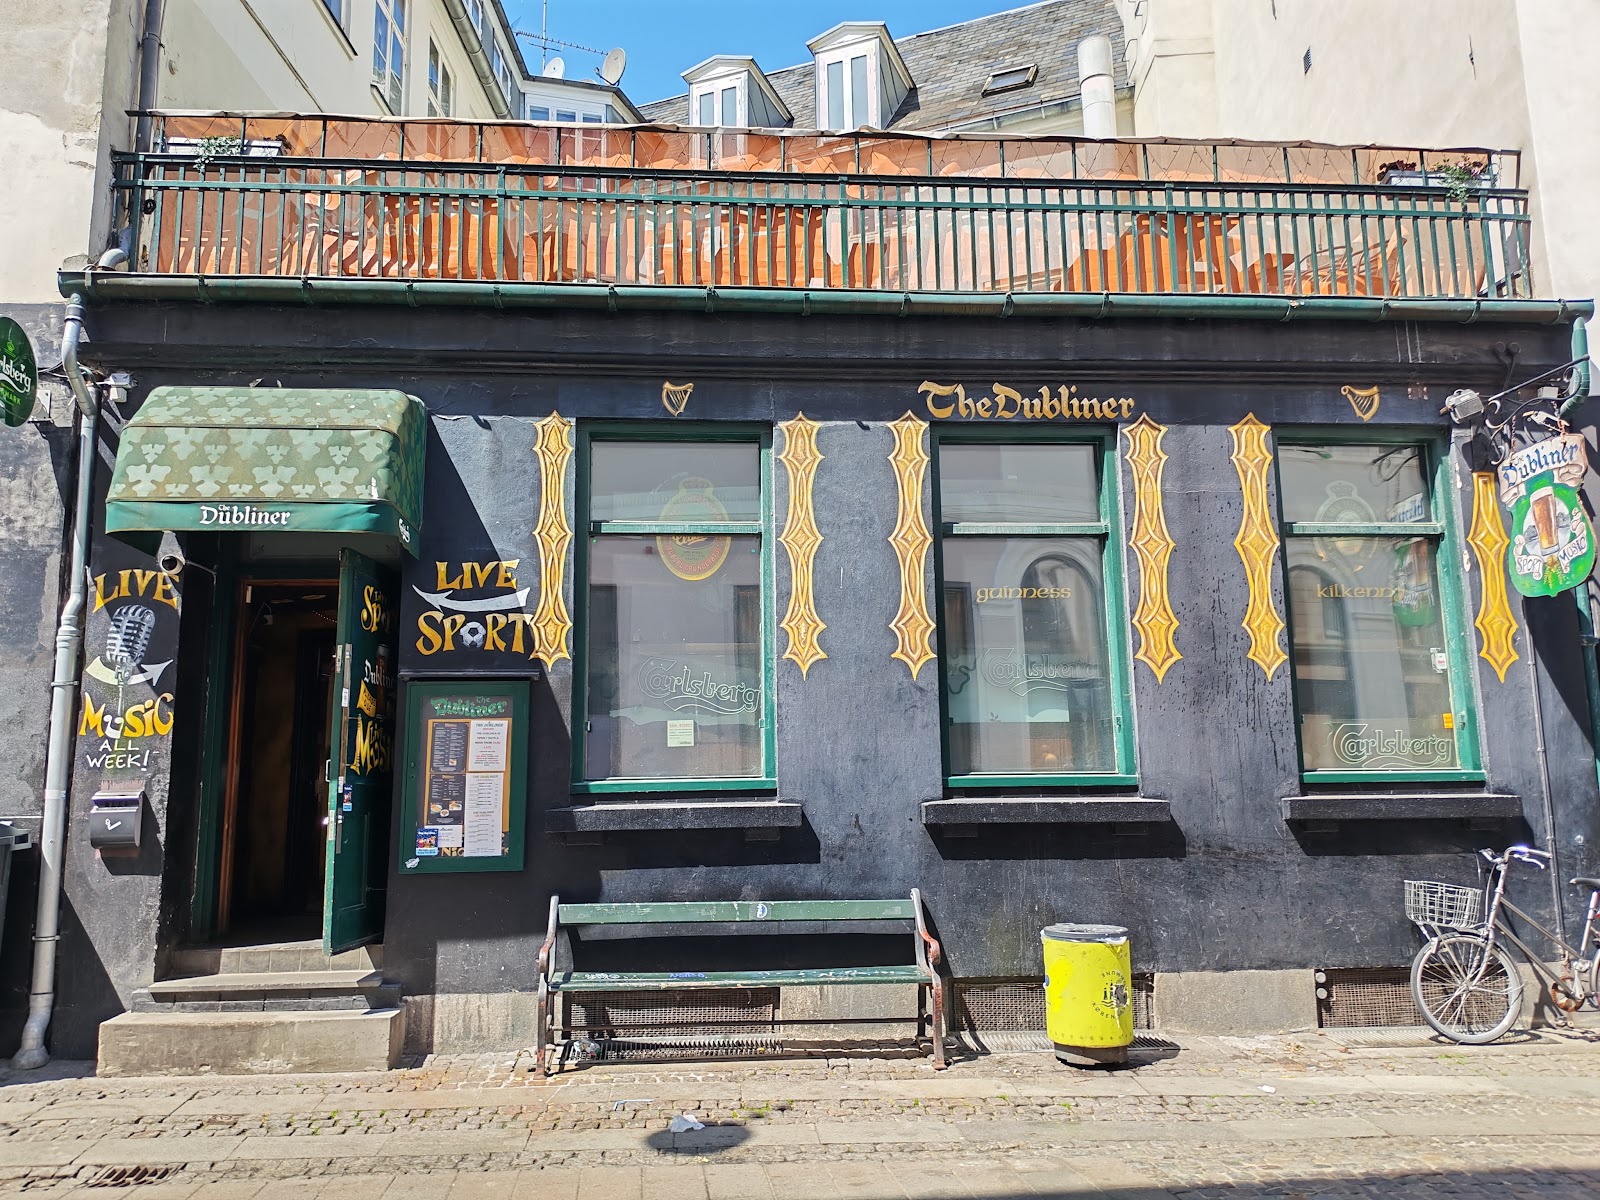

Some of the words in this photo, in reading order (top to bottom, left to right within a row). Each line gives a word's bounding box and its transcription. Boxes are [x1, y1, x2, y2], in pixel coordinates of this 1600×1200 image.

[917, 380, 993, 420] The
[992, 381, 1135, 420] Dubliner
[1502, 443, 1580, 488] Dubliner
[199, 505, 291, 525] Dubliner
[436, 559, 520, 591] LIVE
[1516, 556, 1543, 574] SPORT
[92, 568, 181, 613] LIVE
[975, 586, 1072, 603] guinness
[1316, 583, 1405, 602] kilkenny
[416, 611, 534, 656] SPORT
[638, 656, 761, 713] Carlsberg
[431, 697, 508, 717] Dubliner
[99, 739, 139, 752] ALL
[1333, 724, 1452, 764] Carlsberg
[86, 750, 150, 771] WEEK!
